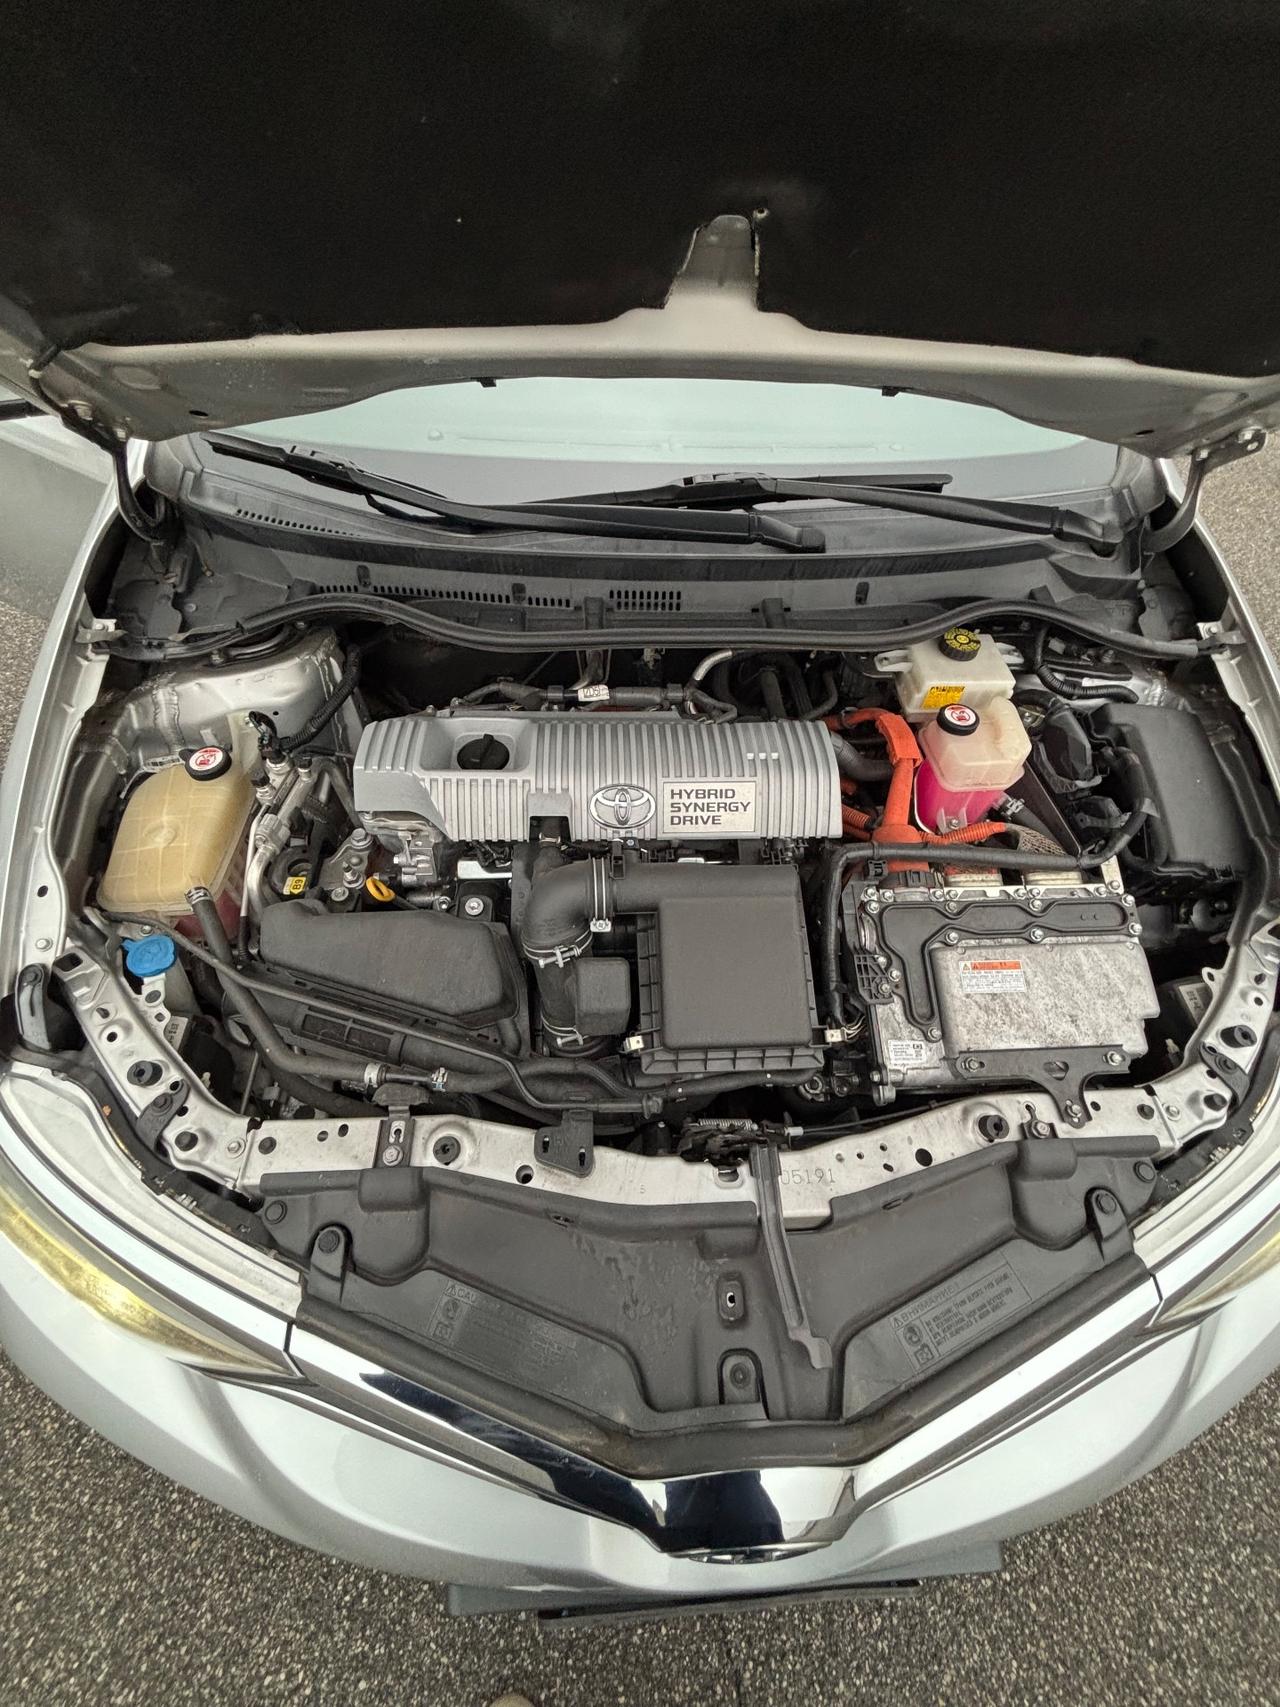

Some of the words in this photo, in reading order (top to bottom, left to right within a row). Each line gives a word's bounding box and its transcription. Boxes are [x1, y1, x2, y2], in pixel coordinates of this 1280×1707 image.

[670, 788, 736, 799] HYBRID
[670, 801, 751, 813] SYNERGY
[670, 815, 722, 826] DRIVE
